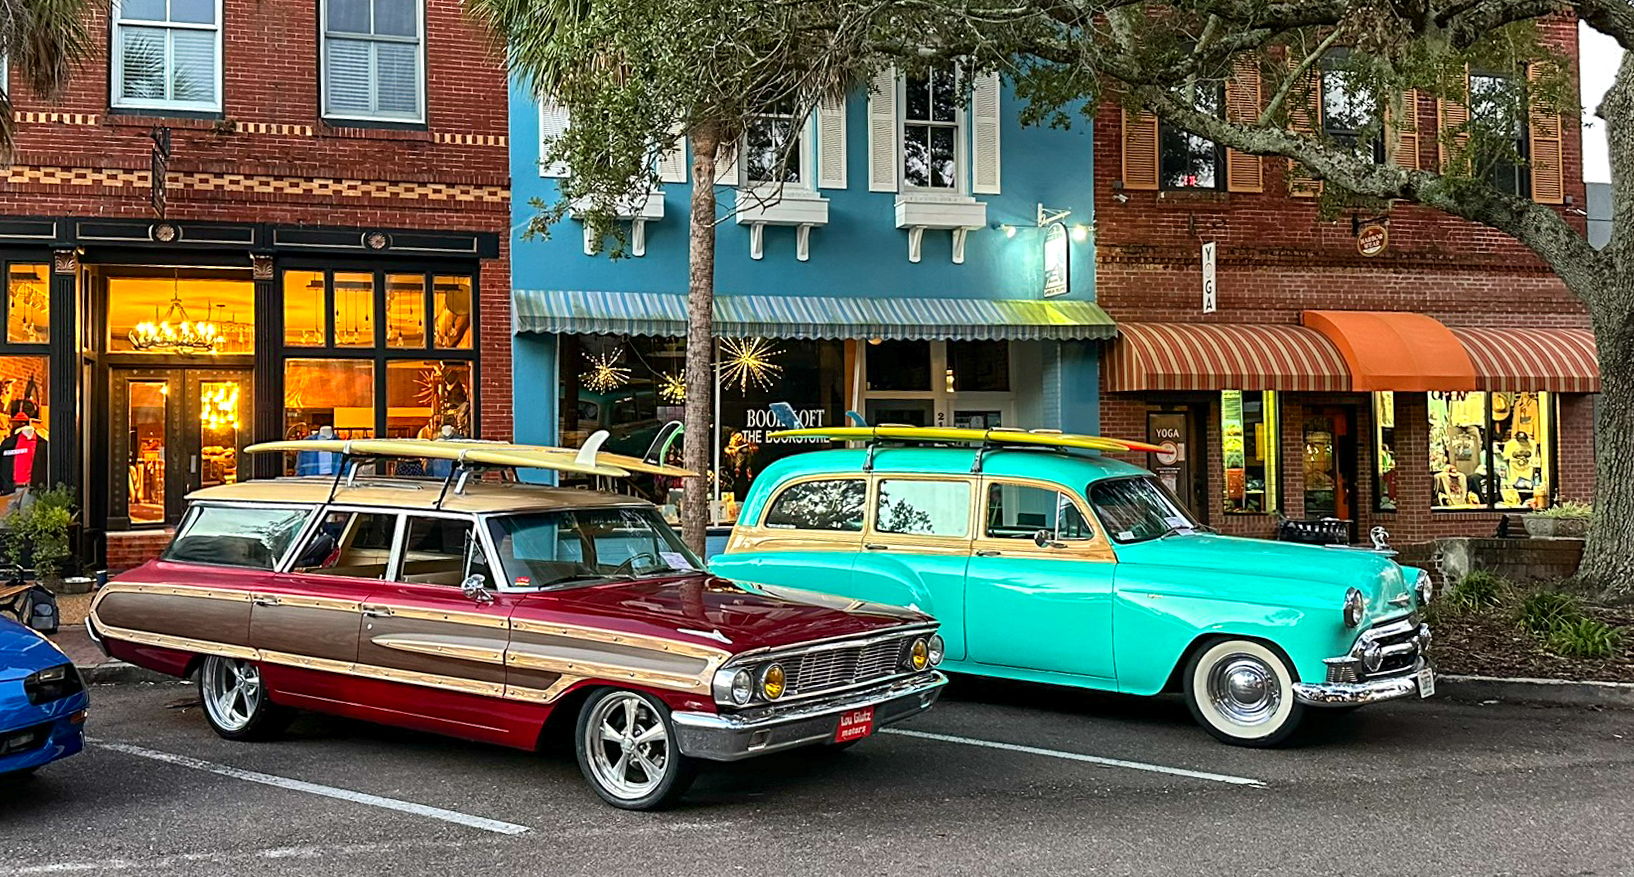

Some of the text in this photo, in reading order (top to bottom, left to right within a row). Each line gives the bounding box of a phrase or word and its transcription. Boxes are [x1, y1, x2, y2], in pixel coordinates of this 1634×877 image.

[1204, 246, 1213, 311] YOGA
[746, 409, 826, 428] BOO OFT
[741, 430, 762, 443] THE
[1156, 428, 1180, 438] YOGA
[840, 716, 853, 726] Lou
[841, 726, 867, 737] motors
